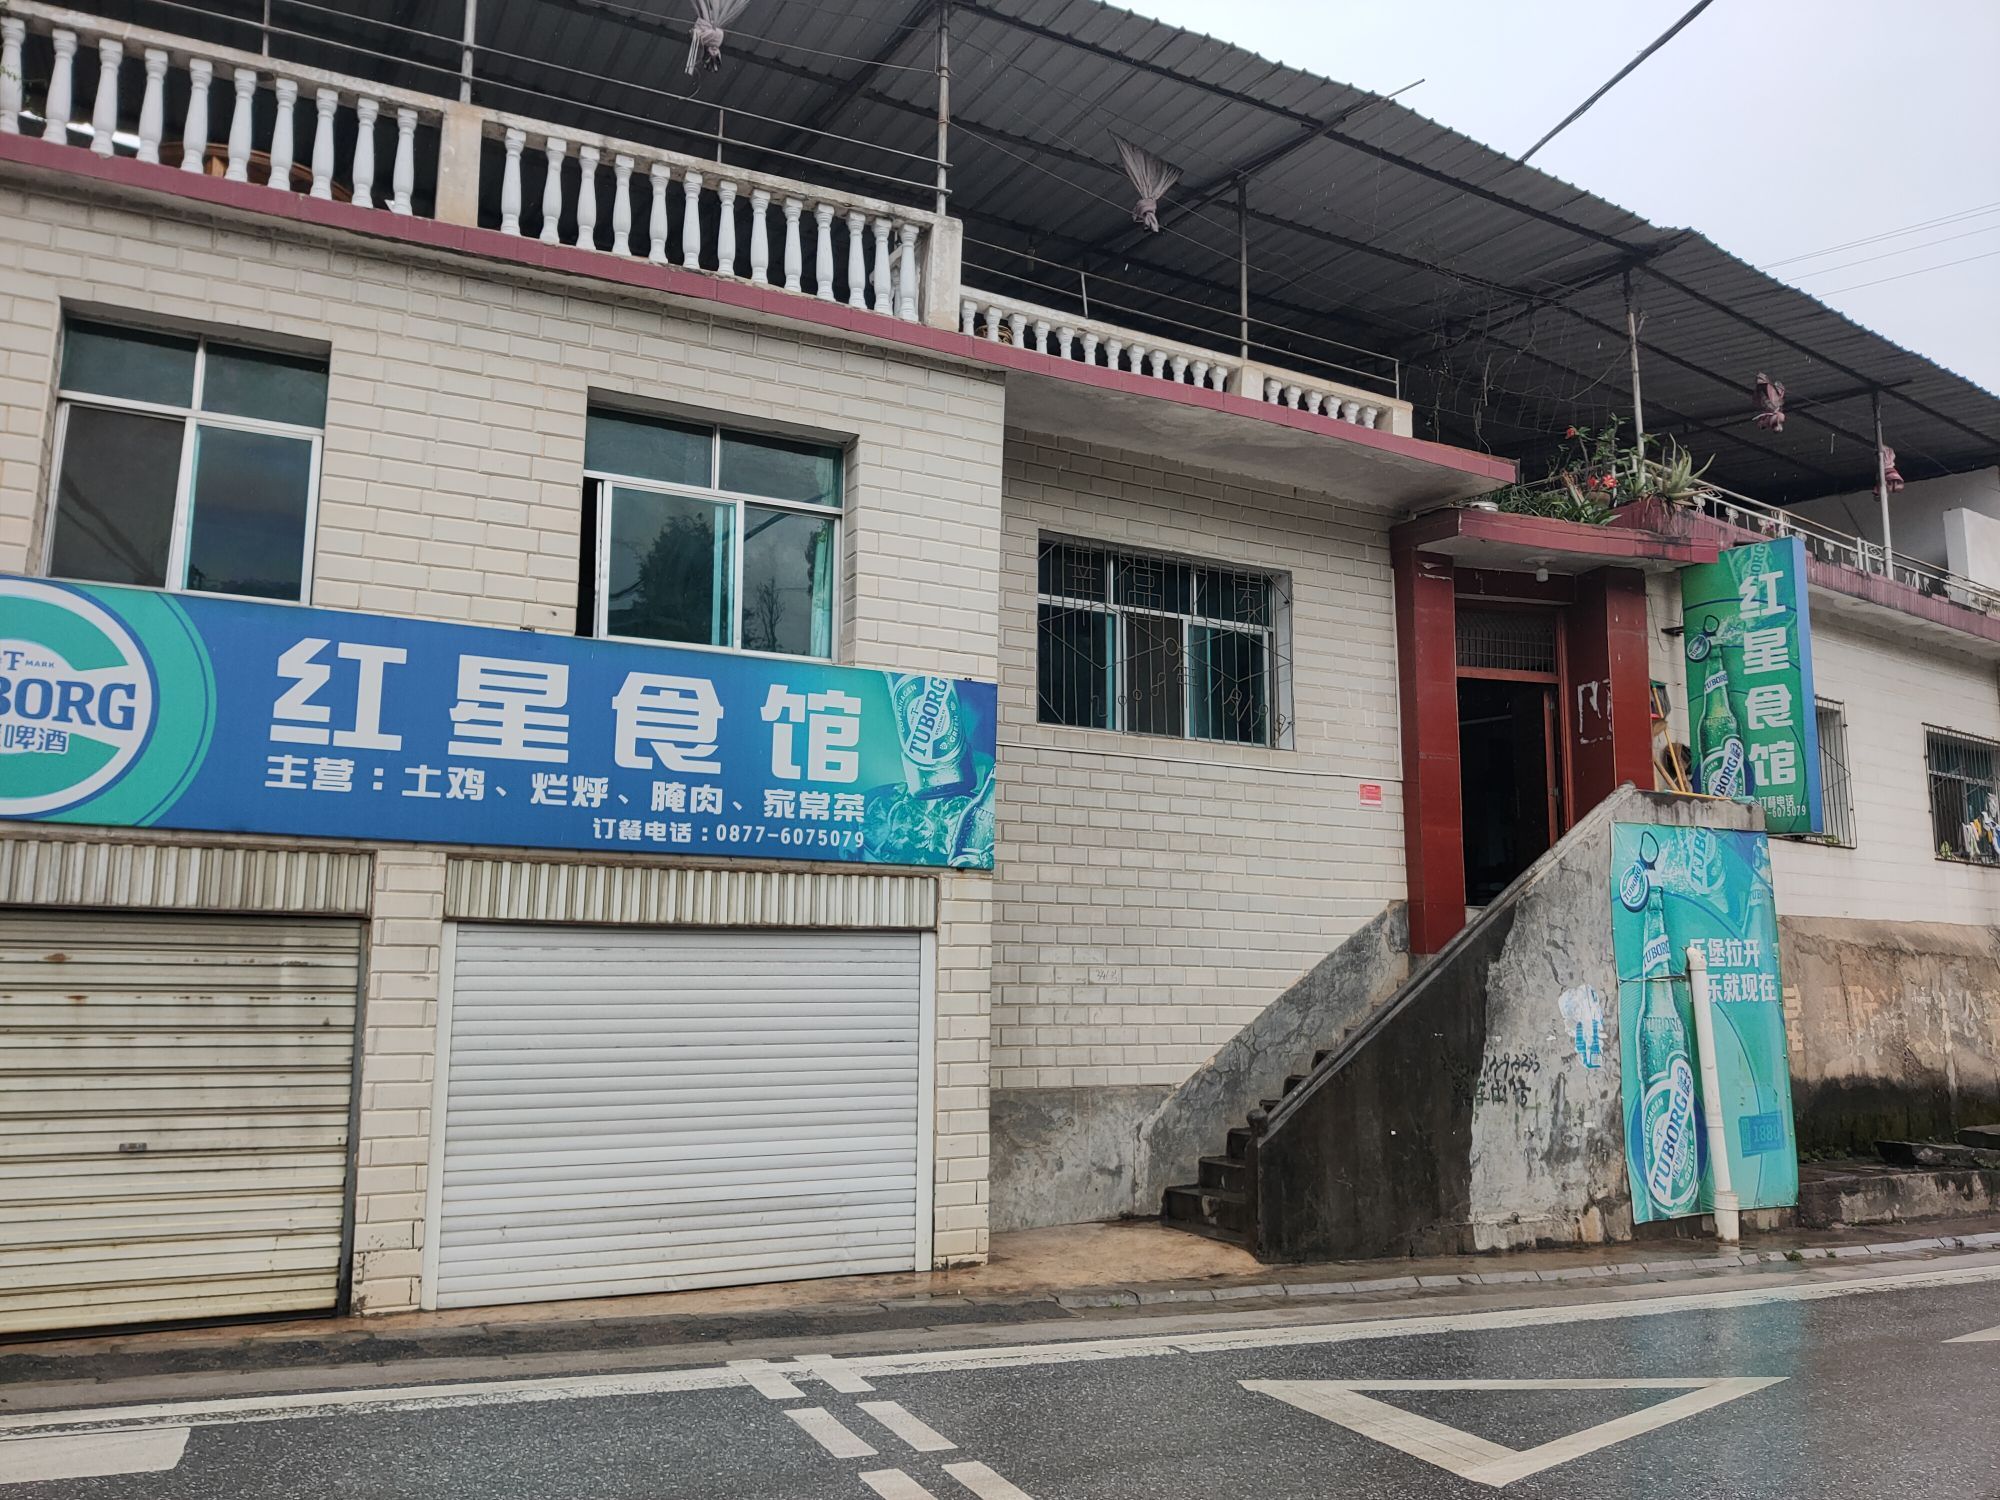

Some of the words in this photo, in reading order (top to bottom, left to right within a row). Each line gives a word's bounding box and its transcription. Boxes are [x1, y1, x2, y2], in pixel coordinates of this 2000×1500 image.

[1738, 570, 1796, 787] 红星食馆
[0, 723, 68, 752] 啤酒
[269, 637, 863, 784] 红星食馆
[908, 677, 949, 757] TUBORG
[1623, 866, 1643, 900] TUBORG
[1686, 972, 1777, 1003] 乐就现在
[1653, 1091, 1689, 1196] TUBORG
[1753, 1125, 1779, 1142] 1880
